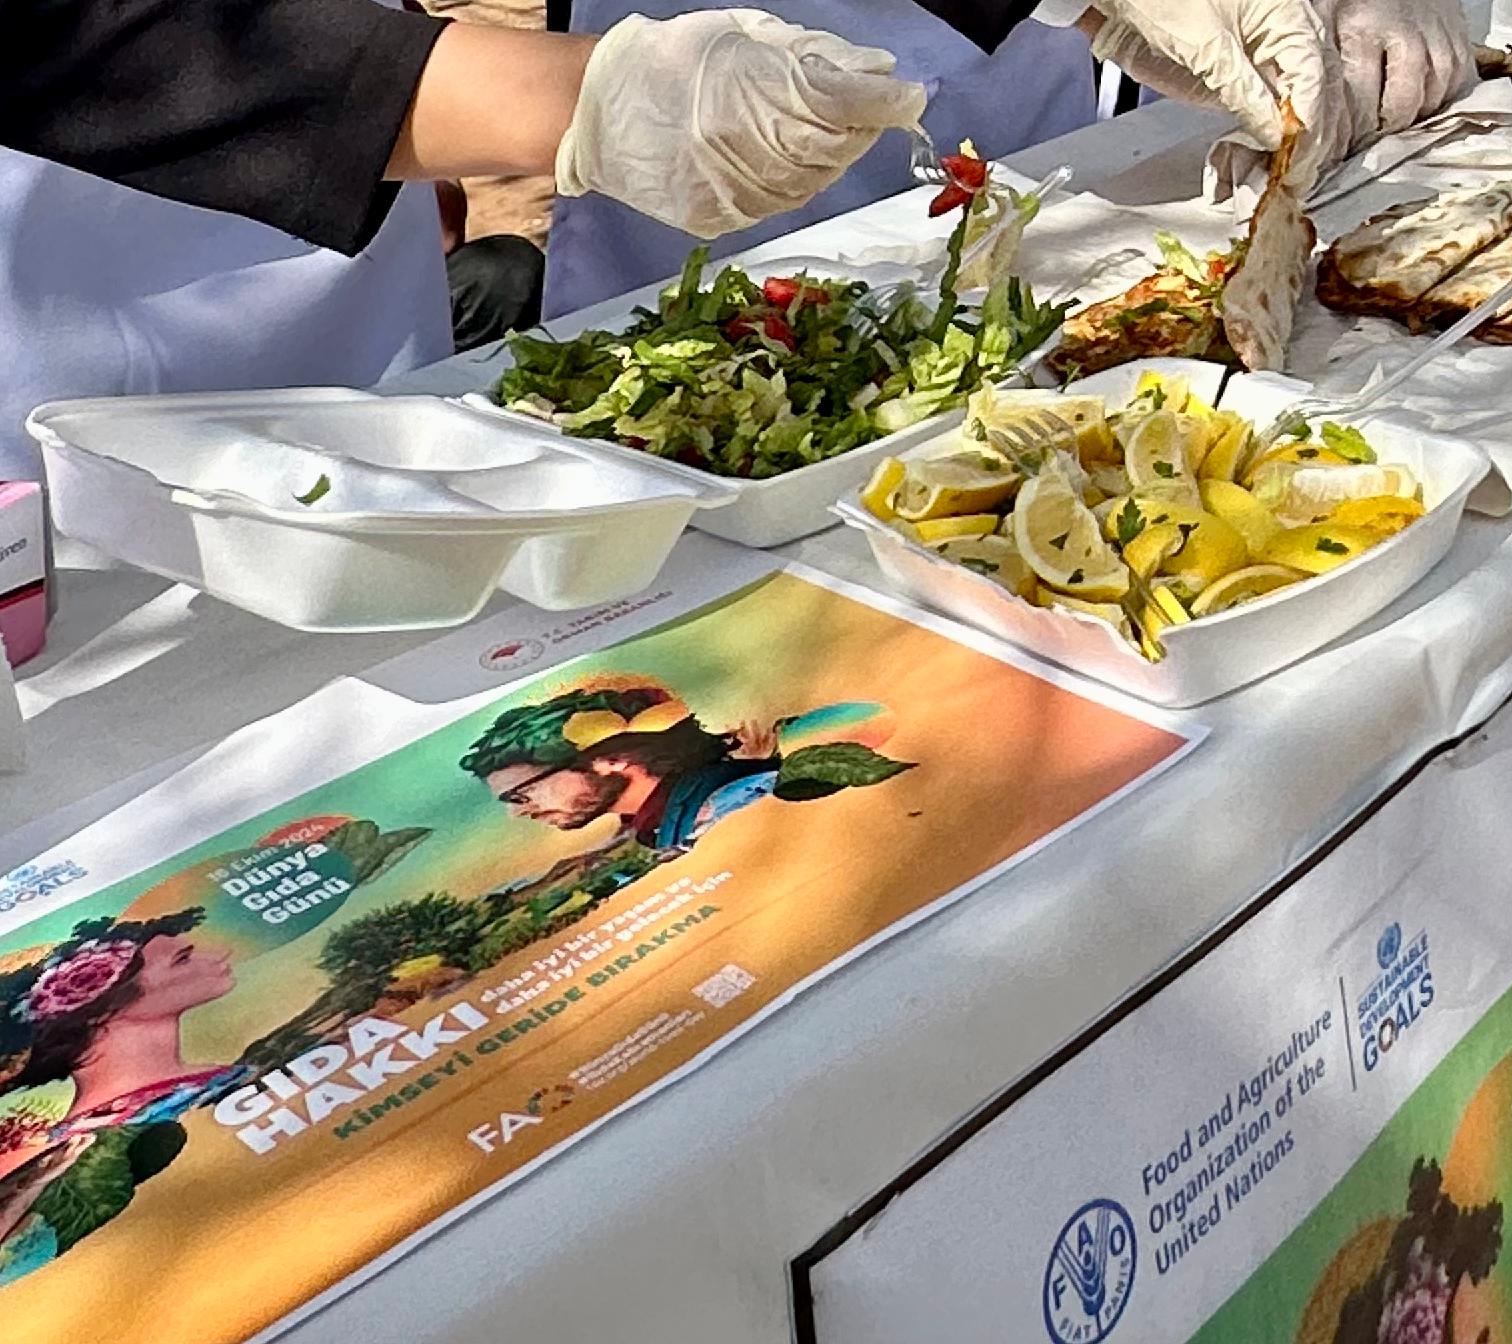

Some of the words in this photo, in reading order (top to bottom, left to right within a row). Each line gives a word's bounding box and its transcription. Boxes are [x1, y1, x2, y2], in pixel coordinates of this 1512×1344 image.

[221, 843, 329, 898] Dünya
[242, 870, 323, 911] Gıda
[262, 877, 352, 924] Günü
[333, 1050, 474, 1140] KİMSEYİ
[475, 985, 587, 1056] GERİDE
[586, 904, 722, 988] BIRAKMA
[481, 969, 536, 1003] daha
[496, 979, 552, 1014] daha
[1363, 972, 1435, 1072] GOALS
[213, 1016, 408, 1127] GIDA
[235, 1001, 490, 1156] HAKKI
[1142, 1128, 1193, 1196] Food
[1198, 1093, 1234, 1149] and
[1237, 1010, 1333, 1115] Agriculture
[1149, 1110, 1272, 1235] Organization
[1275, 1085, 1295, 1119] of
[1296, 1056, 1326, 1097] the
[1155, 1193, 1222, 1276] United
[1224, 1129, 1295, 1212] Nations
[1052, 1220, 1127, 1311] FAO
